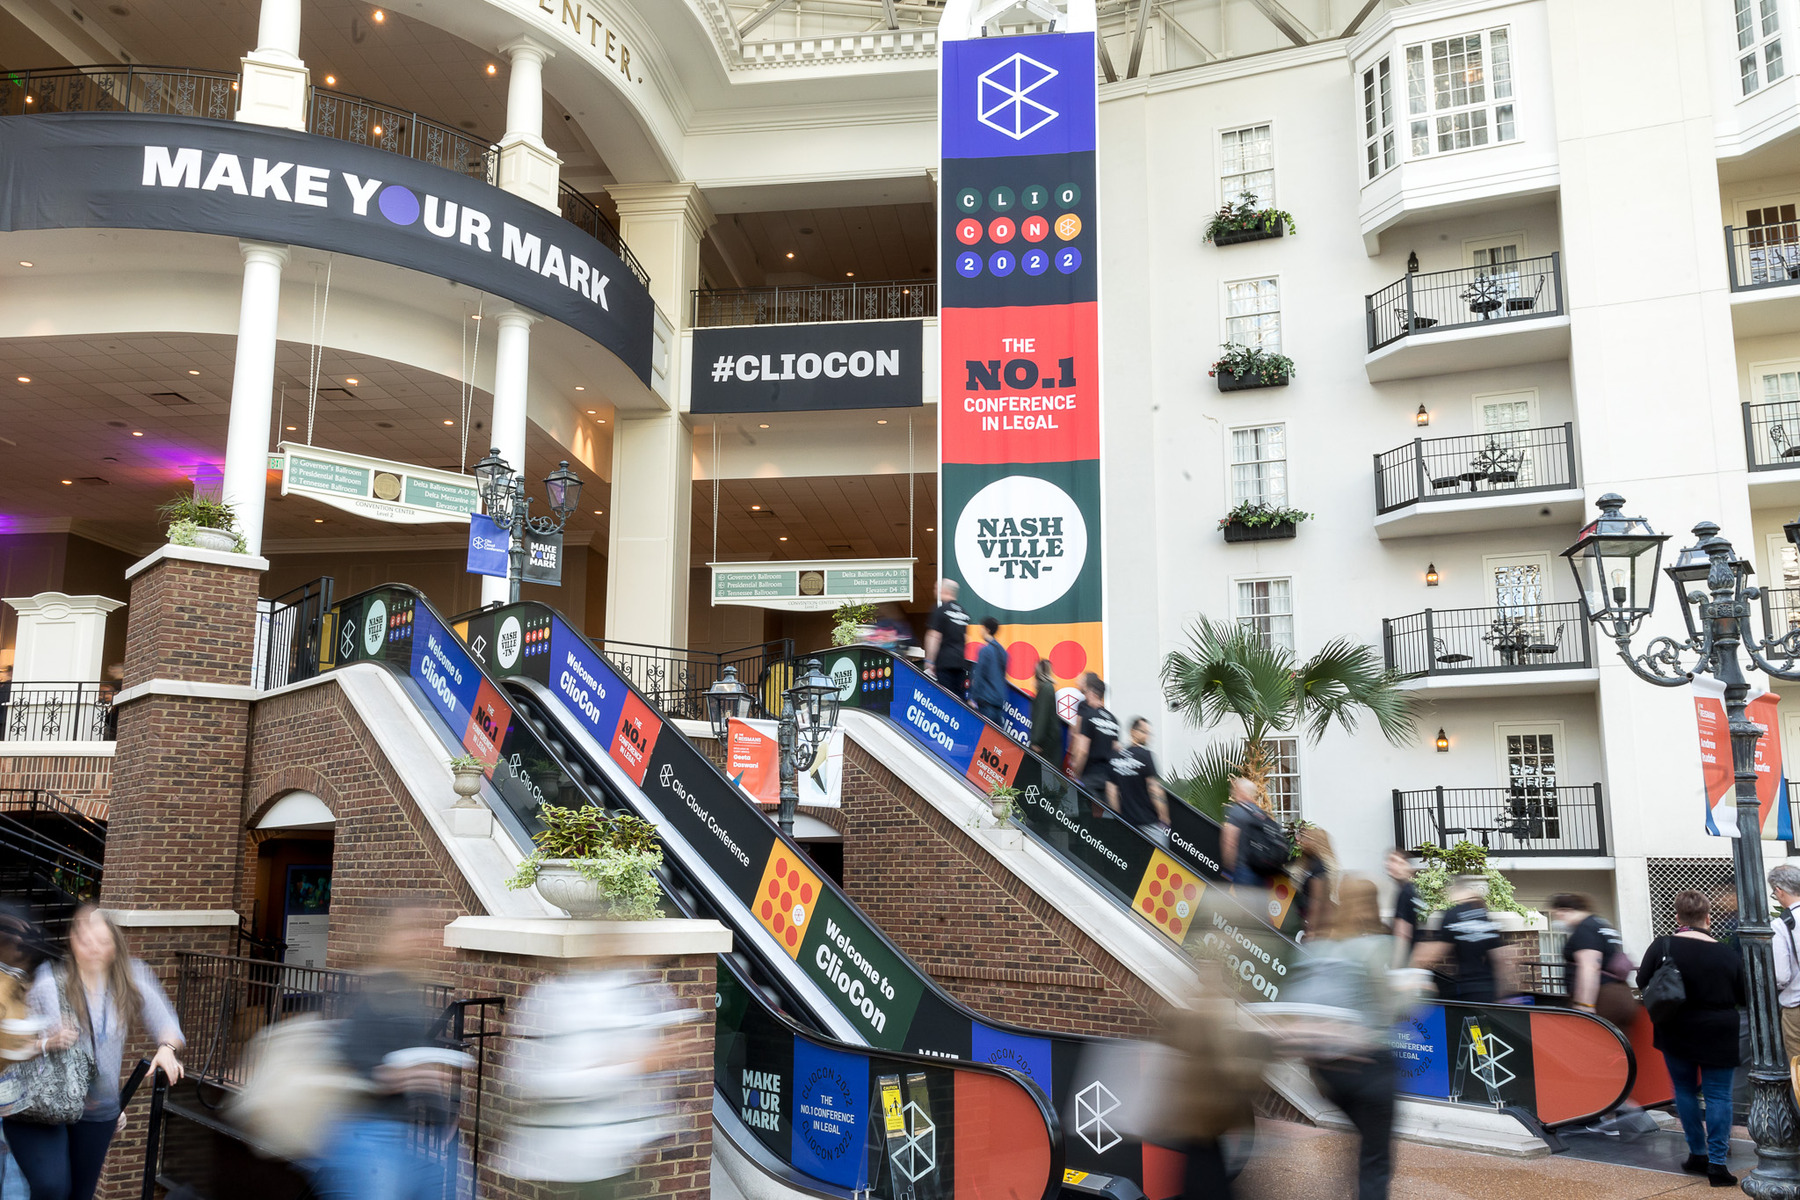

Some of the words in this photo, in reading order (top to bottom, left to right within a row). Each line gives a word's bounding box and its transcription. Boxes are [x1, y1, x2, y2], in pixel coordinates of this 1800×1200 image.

[142, 146, 330, 208] MAKE
[342, 172, 492, 252] YOUR
[502, 221, 610, 312] MARK
[1002, 338, 1036, 353] THE
[711, 349, 899, 382] #CLIOCON
[966, 356, 1076, 391] NO.1
[964, 394, 1076, 413] CONFERENCE
[982, 416, 999, 431] IN
[1003, 415, 1058, 430] LEGAL
[298, 468, 334, 481] Presidential
[334, 473, 362, 486] Ballroom
[299, 459, 334, 472] Governor's
[335, 464, 362, 476] Ballroom
[298, 477, 330, 489] Tennessee
[330, 482, 358, 493] Ballroom
[413, 479, 429, 489] Delta
[429, 482, 457, 494] Ballrooms
[355, 500, 394, 512] CONVENTION
[394, 506, 416, 516] CENTER
[424, 490, 440, 500] Delta
[440, 493, 469, 505] Mezzanine
[435, 501, 459, 511] Elevator
[459, 504, 468, 513] D4
[376, 509, 390, 517] Level
[977, 516, 1064, 538] NASH
[530, 542, 557, 554] MAKE
[530, 550, 557, 562] YOUR
[977, 538, 1064, 559] VILLE
[529, 558, 556, 569] MARK
[857, 570, 884, 578] Ballrooms
[369, 615, 384, 626] NASH
[501, 631, 518, 642] NASH
[501, 639, 517, 650] VILLE
[427, 633, 455, 677] Welcome
[454, 667, 463, 685] to
[421, 654, 457, 713] ClioCon
[566, 650, 598, 691] Welcome
[596, 683, 606, 699] to
[834, 669, 853, 678] NASH
[834, 677, 853, 686] VILLE
[560, 670, 601, 725] ClioCon
[486, 703, 495, 717] THE
[913, 688, 950, 723] Welcome
[949, 716, 960, 731] to
[1002, 700, 1033, 729] Welcom
[475, 704, 499, 743] NO.1
[634, 716, 643, 730] THE
[906, 704, 954, 752] ClioCon
[471, 721, 494, 753] CONFERENCE
[621, 719, 648, 753] NO.1
[618, 733, 643, 763] CONFERENCE
[624, 750, 636, 767] LEGAL
[993, 745, 1003, 757] THE
[976, 759, 1005, 785] CONFERENCE
[980, 746, 1009, 777] NO.1
[520, 769, 533, 791] Clio
[672, 779, 687, 800] Clio
[686, 794, 709, 823] Cloud
[707, 816, 750, 868] Conference
[1039, 797, 1055, 815] Clio
[1055, 809, 1081, 834] Cloud
[1080, 828, 1128, 871] Conference
[1171, 832, 1220, 872] Conference
[1212, 911, 1271, 965] Welcome
[1271, 957, 1287, 976] to
[825, 917, 880, 985] Welcome
[879, 976, 895, 1001] to
[815, 943, 887, 1034] ClioCon
[1391, 1041, 1434, 1053] CONFERENCE
[1397, 1032, 1411, 1041] THE
[987, 1048, 1015, 1064] IOCON
[1016, 1054, 1035, 1081] 202
[1398, 1051, 1421, 1061] LEGAL
[742, 1068, 781, 1093] MAKE
[802, 1066, 834, 1099] CLIOCON
[835, 1074, 853, 1107] 2022
[742, 1088, 780, 1113] YOUR
[820, 1094, 833, 1106] THE
[741, 1107, 780, 1132] MARK
[800, 1104, 814, 1116] NO.1
[813, 1107, 855, 1125] CONFERENCE
[813, 1120, 820, 1130] IN
[820, 1121, 841, 1135] LEGAL
[802, 1120, 833, 1160] CLIOCON
[834, 1129, 853, 1159] 2022
